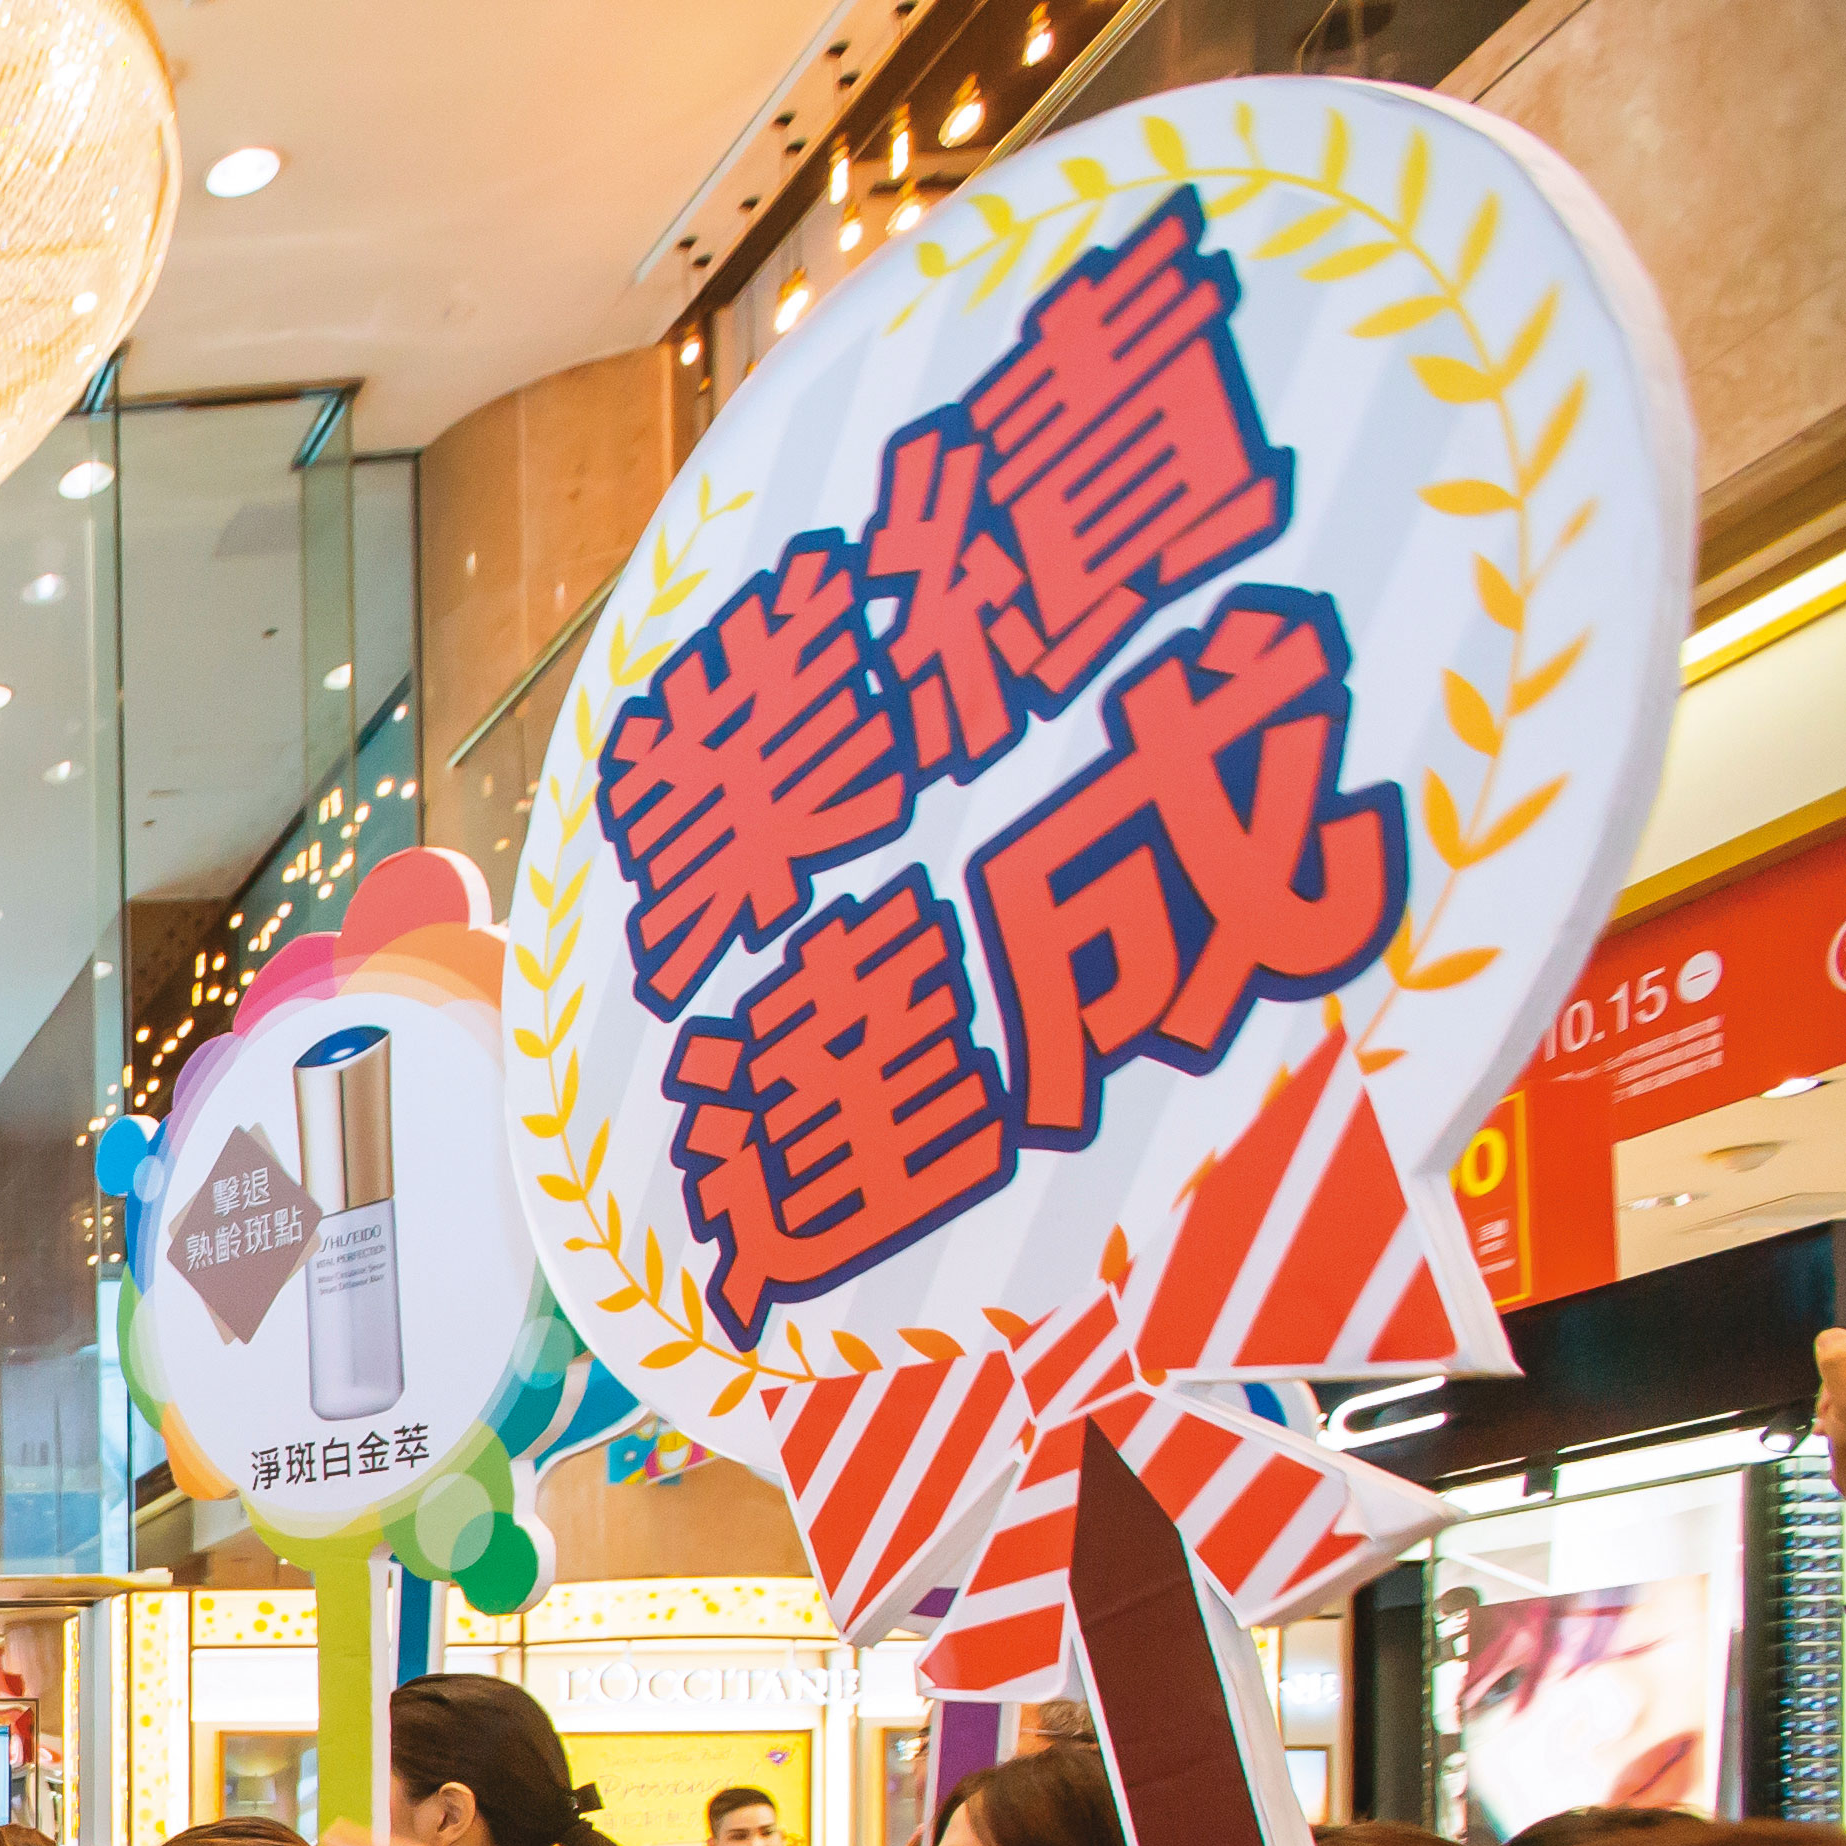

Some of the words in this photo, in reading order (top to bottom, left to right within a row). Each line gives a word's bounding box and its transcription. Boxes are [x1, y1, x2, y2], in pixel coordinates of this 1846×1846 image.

[597, 181, 1296, 1024] 業績
[659, 582, 1409, 1349] 達成
[212, 1166, 271, 1218] 擊退
[185, 1205, 304, 1273] 熟齡斑點
[319, 1224, 382, 1253] SHISEIDO
[250, 1422, 431, 1493] 淨斑白金萃
